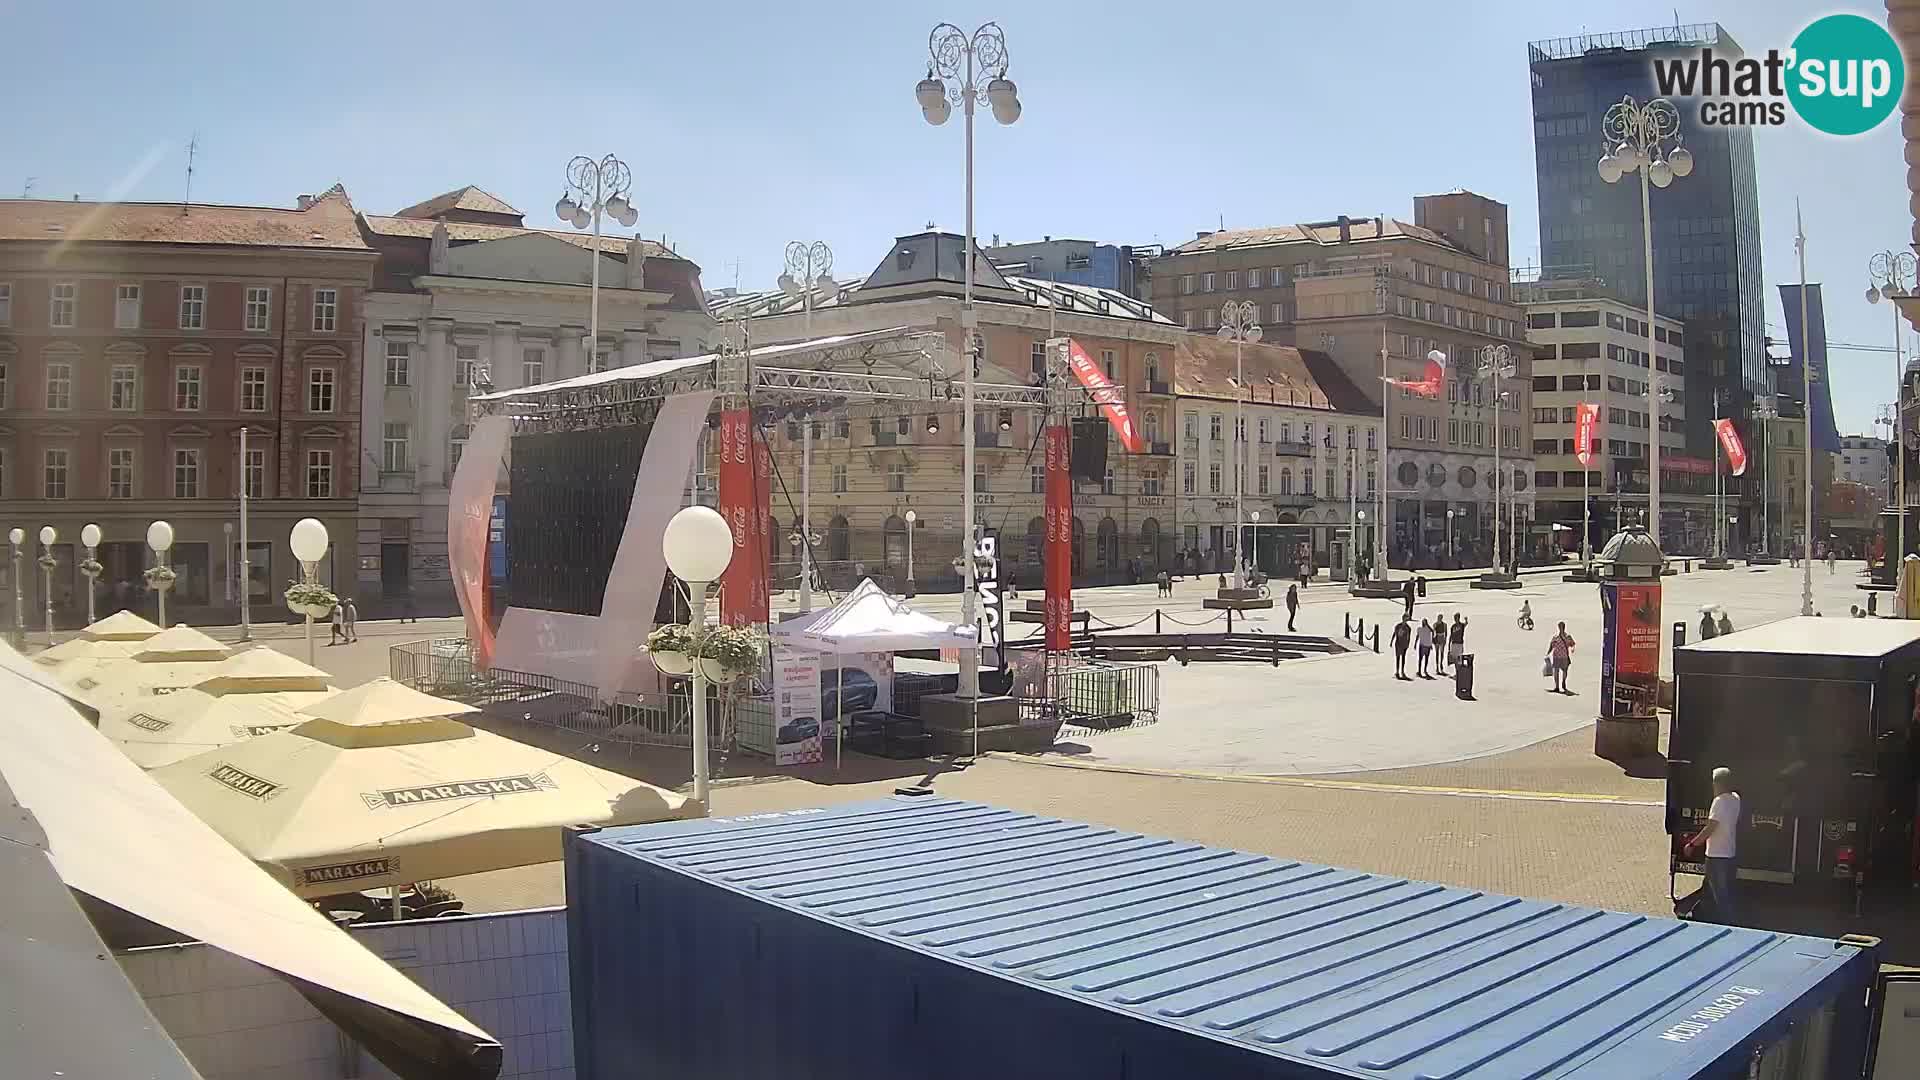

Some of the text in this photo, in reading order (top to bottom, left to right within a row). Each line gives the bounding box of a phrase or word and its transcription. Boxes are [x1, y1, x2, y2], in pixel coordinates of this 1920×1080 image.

[735, 422, 747, 464] Coca-Cola
[734, 506, 746, 548] Coca-Cola
[1047, 507, 1057, 543] Coca-Cola
[1059, 508, 1069, 543] Coca-Cola
[218, 766, 275, 797] MARASKA
[393, 779, 532, 805] MARASKA
[310, 861, 386, 882] MARASKA
